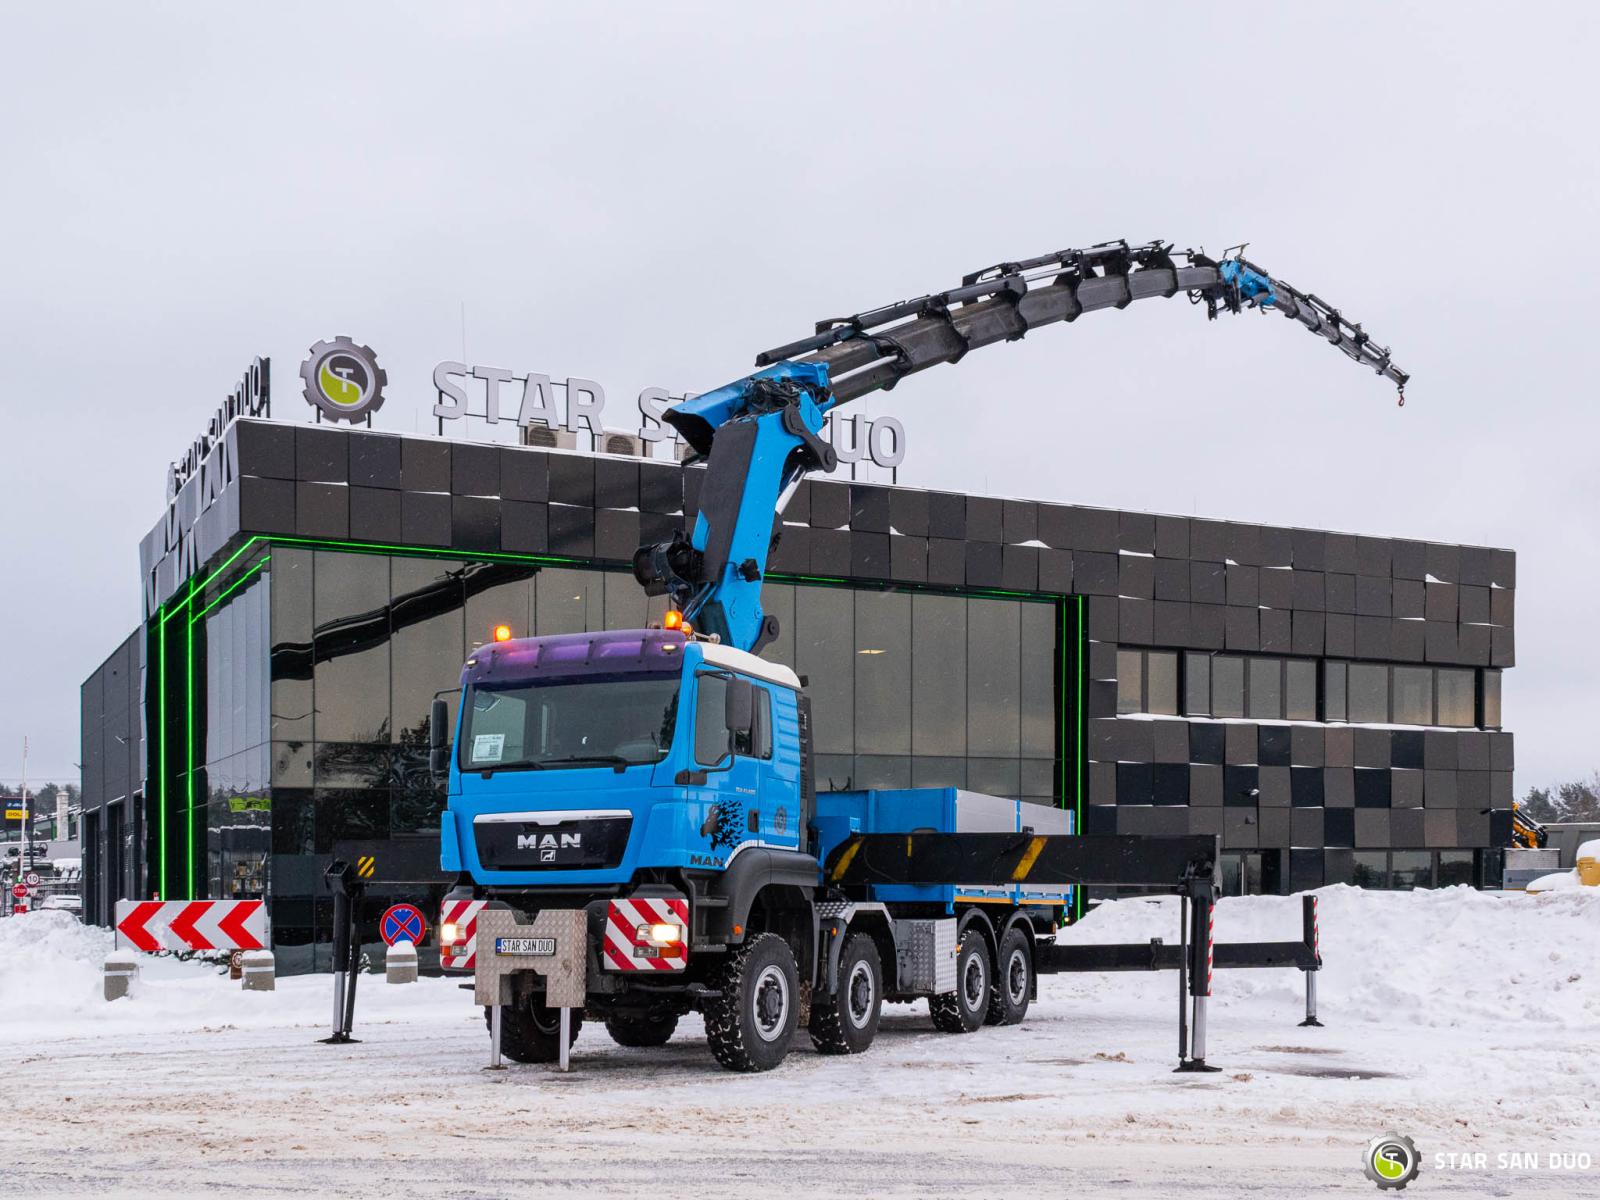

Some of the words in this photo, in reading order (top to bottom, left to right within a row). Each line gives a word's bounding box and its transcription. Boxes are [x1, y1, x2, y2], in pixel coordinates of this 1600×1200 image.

[433, 361, 605, 436] STAR
[830, 411, 906, 467] UO
[517, 833, 581, 849] MAN
[690, 854, 724, 867] MAN
[502, 940, 521, 951] STAR
[522, 940, 537, 951] SAN
[538, 940, 553, 951] DUO
